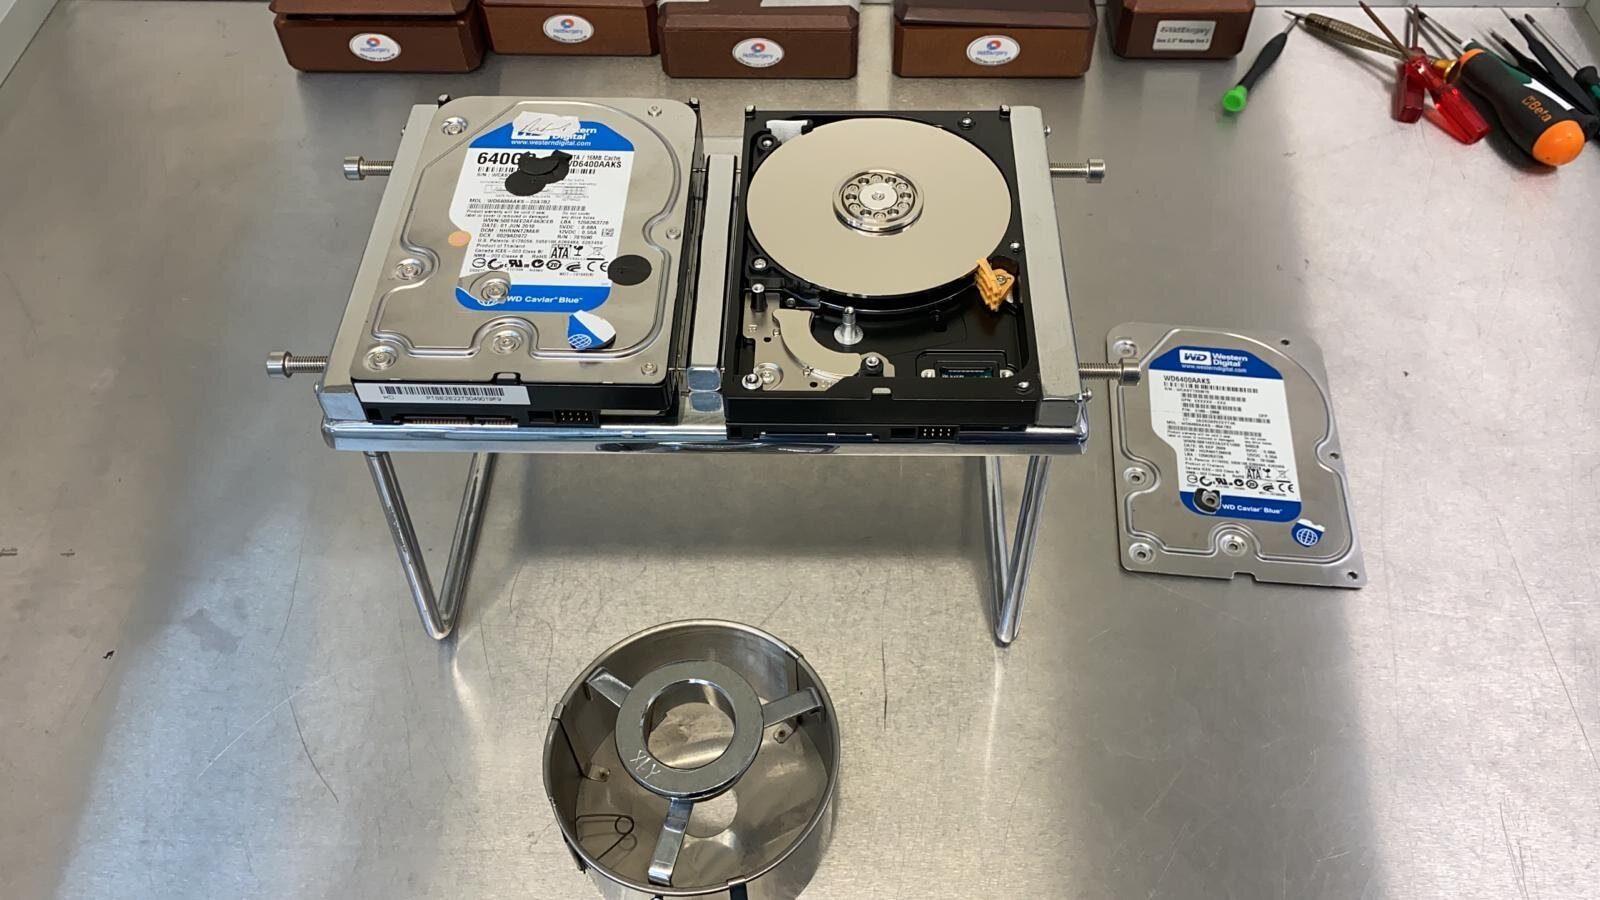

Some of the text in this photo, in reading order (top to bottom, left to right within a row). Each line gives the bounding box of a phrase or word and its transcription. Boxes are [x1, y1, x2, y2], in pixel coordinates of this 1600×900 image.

[1184, 352, 1248, 362] WD Western
[1212, 359, 1242, 367] Digital
[1236, 504, 1260, 512] Caviar
